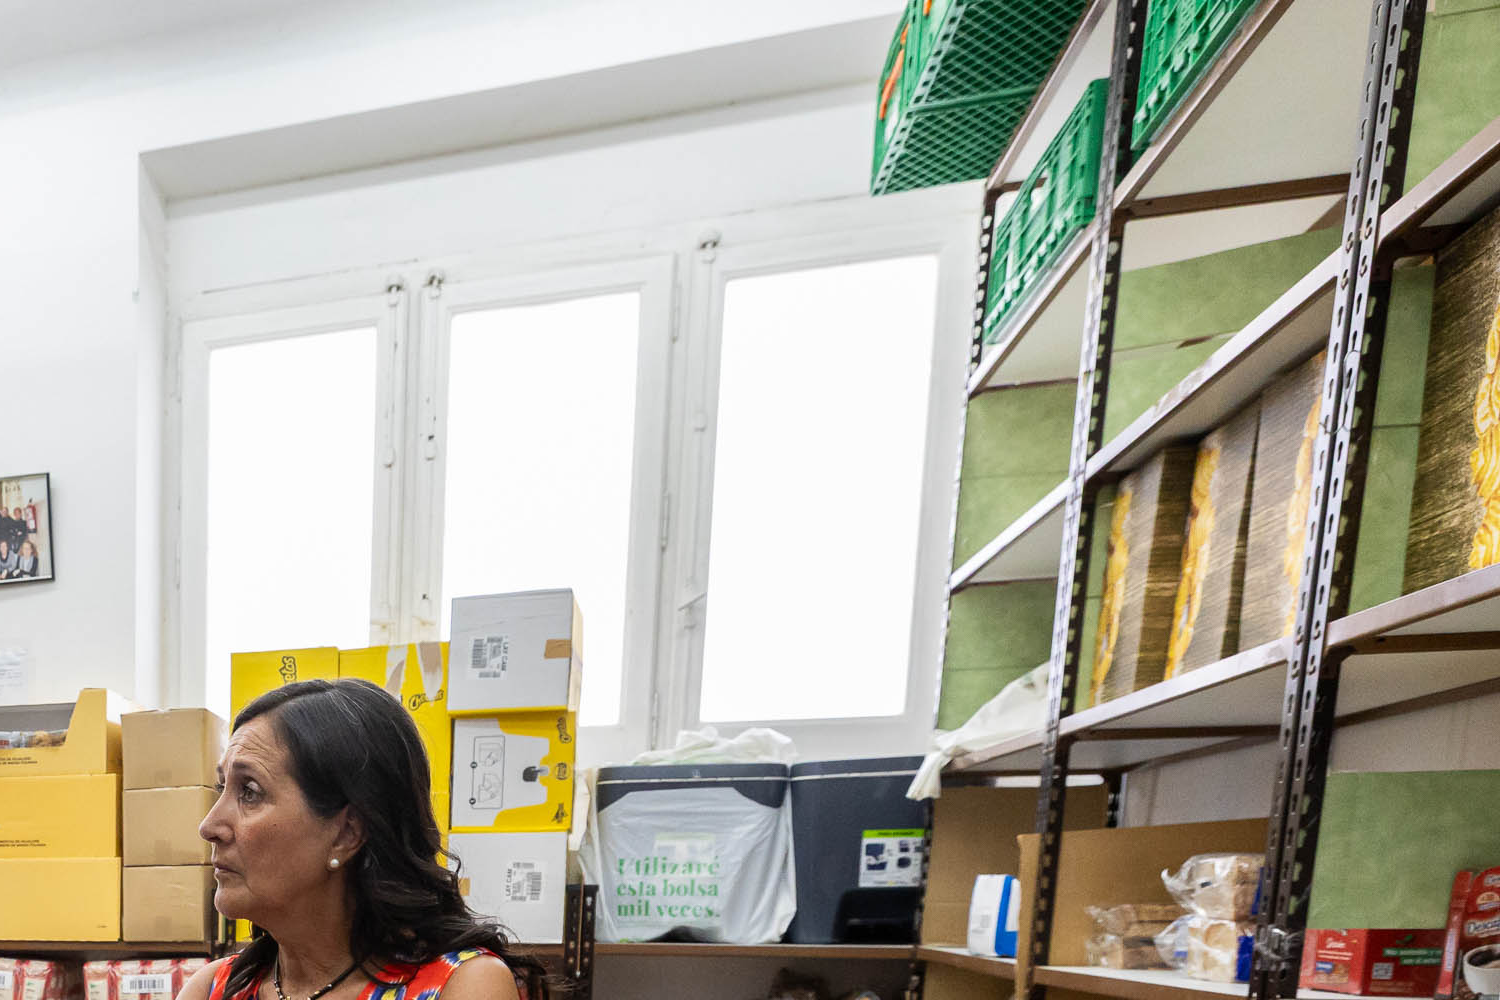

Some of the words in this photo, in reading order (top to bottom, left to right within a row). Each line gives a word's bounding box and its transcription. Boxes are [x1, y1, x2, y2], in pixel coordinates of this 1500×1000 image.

[617, 855, 720, 875] Utilizaré
[617, 881, 656, 897] esta
[663, 879, 719, 897] bolsa
[617, 899, 650, 917] mil
[656, 903, 721, 918] veces.
